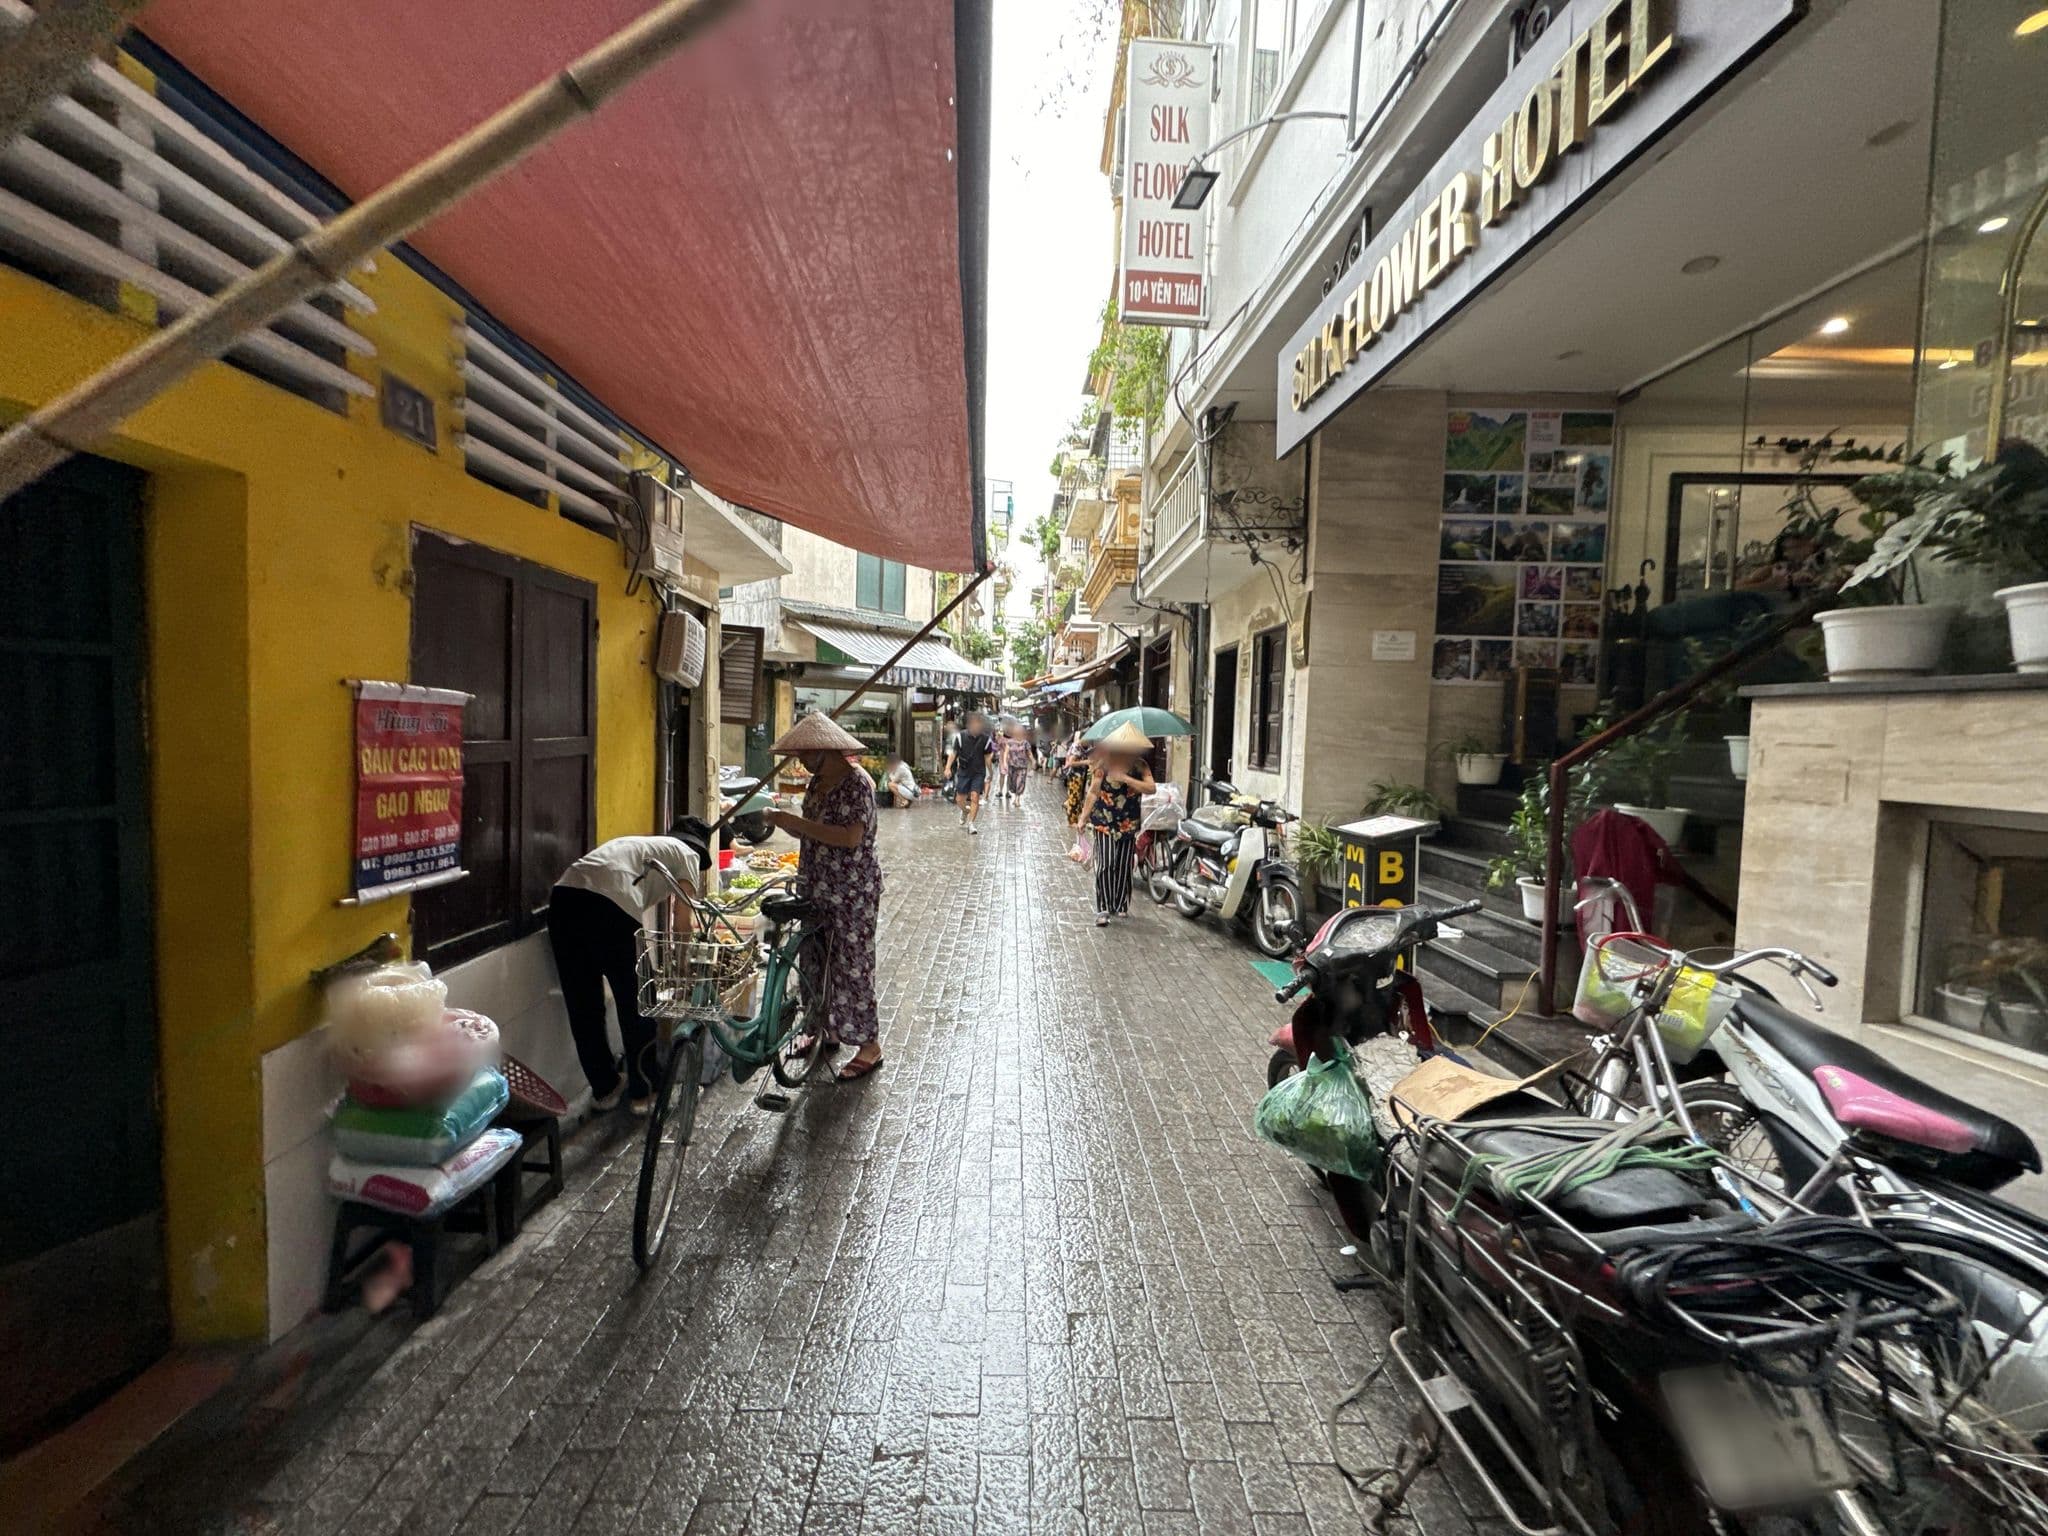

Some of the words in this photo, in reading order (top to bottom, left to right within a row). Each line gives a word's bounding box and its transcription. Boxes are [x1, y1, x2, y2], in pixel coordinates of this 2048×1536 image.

[1150, 104, 1190, 144] SILK
[1133, 161, 1189, 200] FLOW
[1291, 313, 1342, 412] SILK
[1343, 171, 1475, 365] FLOWER
[1481, 0, 1673, 230] HOTEL
[1138, 220, 1194, 260] HOTEL
[1151, 277, 1171, 305] YÊN
[1175, 280, 1199, 306] THÁI
[399, 396, 425, 434] 21
[361, 743, 394, 774] BÁN
[399, 742, 427, 772] CÁC
[376, 791, 408, 823] GẠO
[414, 787, 450, 815] NGON
